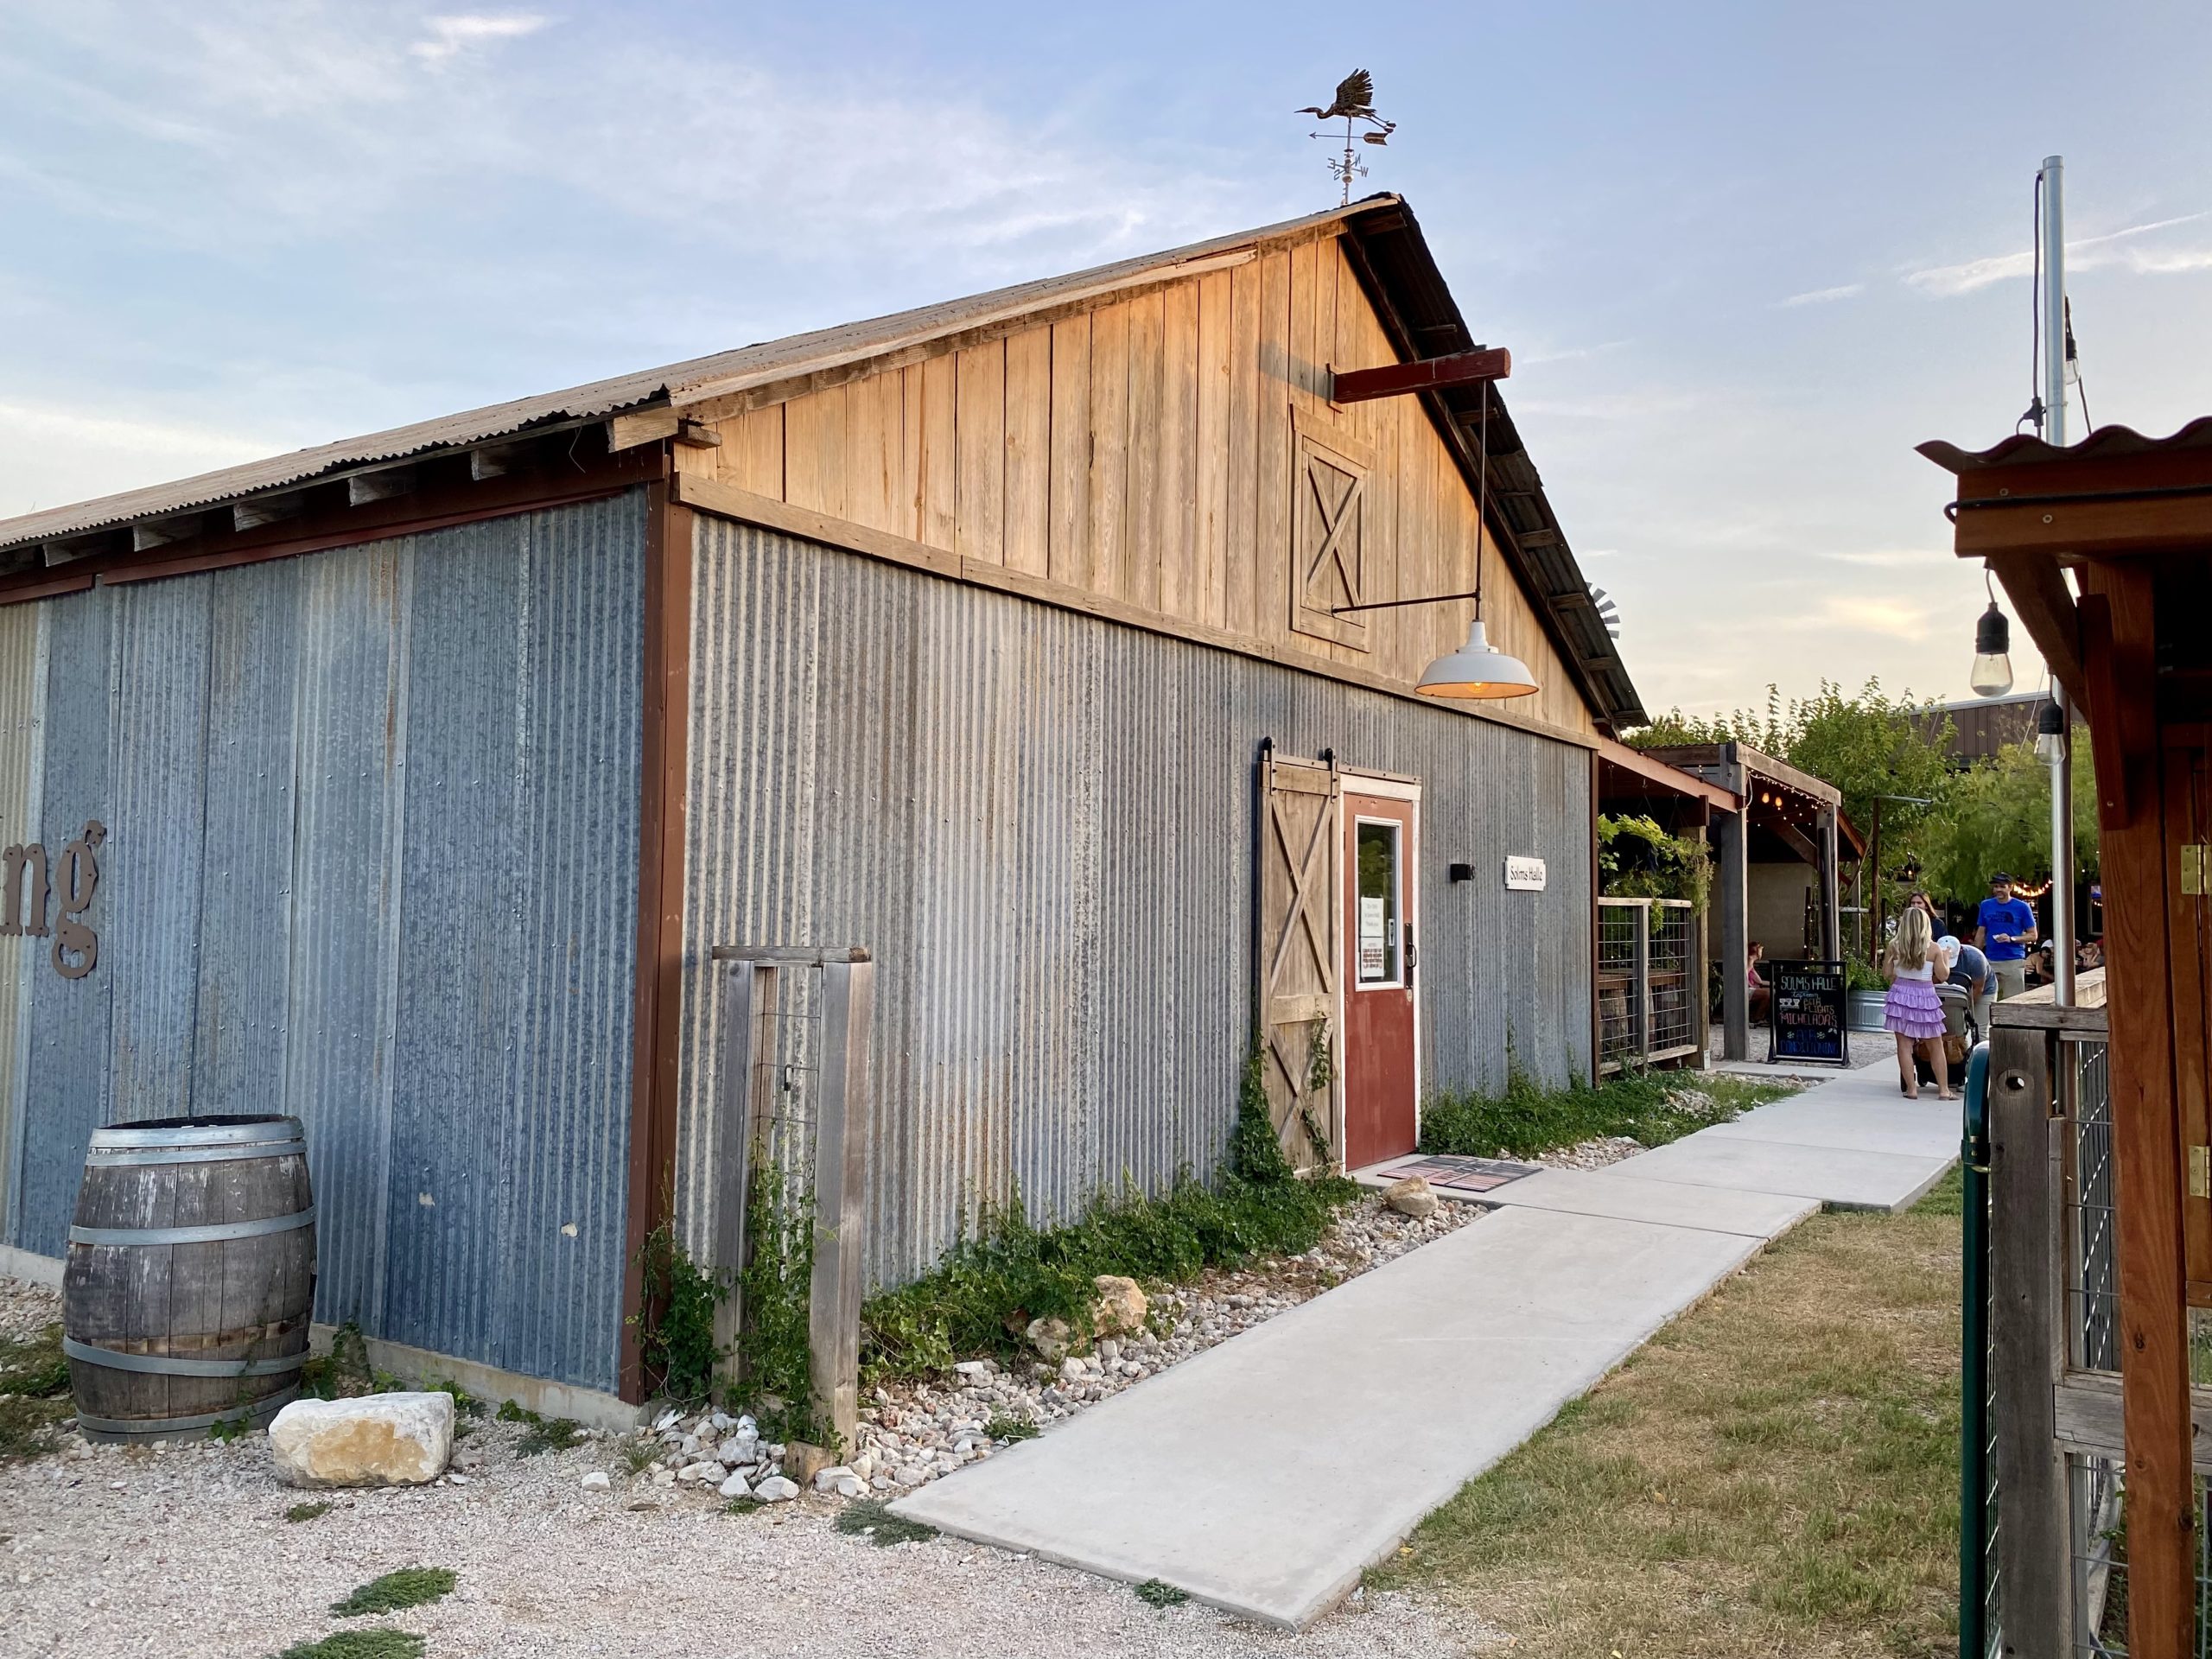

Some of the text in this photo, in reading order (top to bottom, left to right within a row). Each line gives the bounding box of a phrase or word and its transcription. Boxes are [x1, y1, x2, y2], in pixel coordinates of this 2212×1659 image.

[1360, 166, 1369, 177] W
[1510, 865, 1542, 881] Solms Halle
[1781, 976, 1837, 991] SOLMS HALLE
[1803, 1005, 1835, 1015] FLIGHTS
[1780, 1013, 1837, 1027] MICHELADAS
